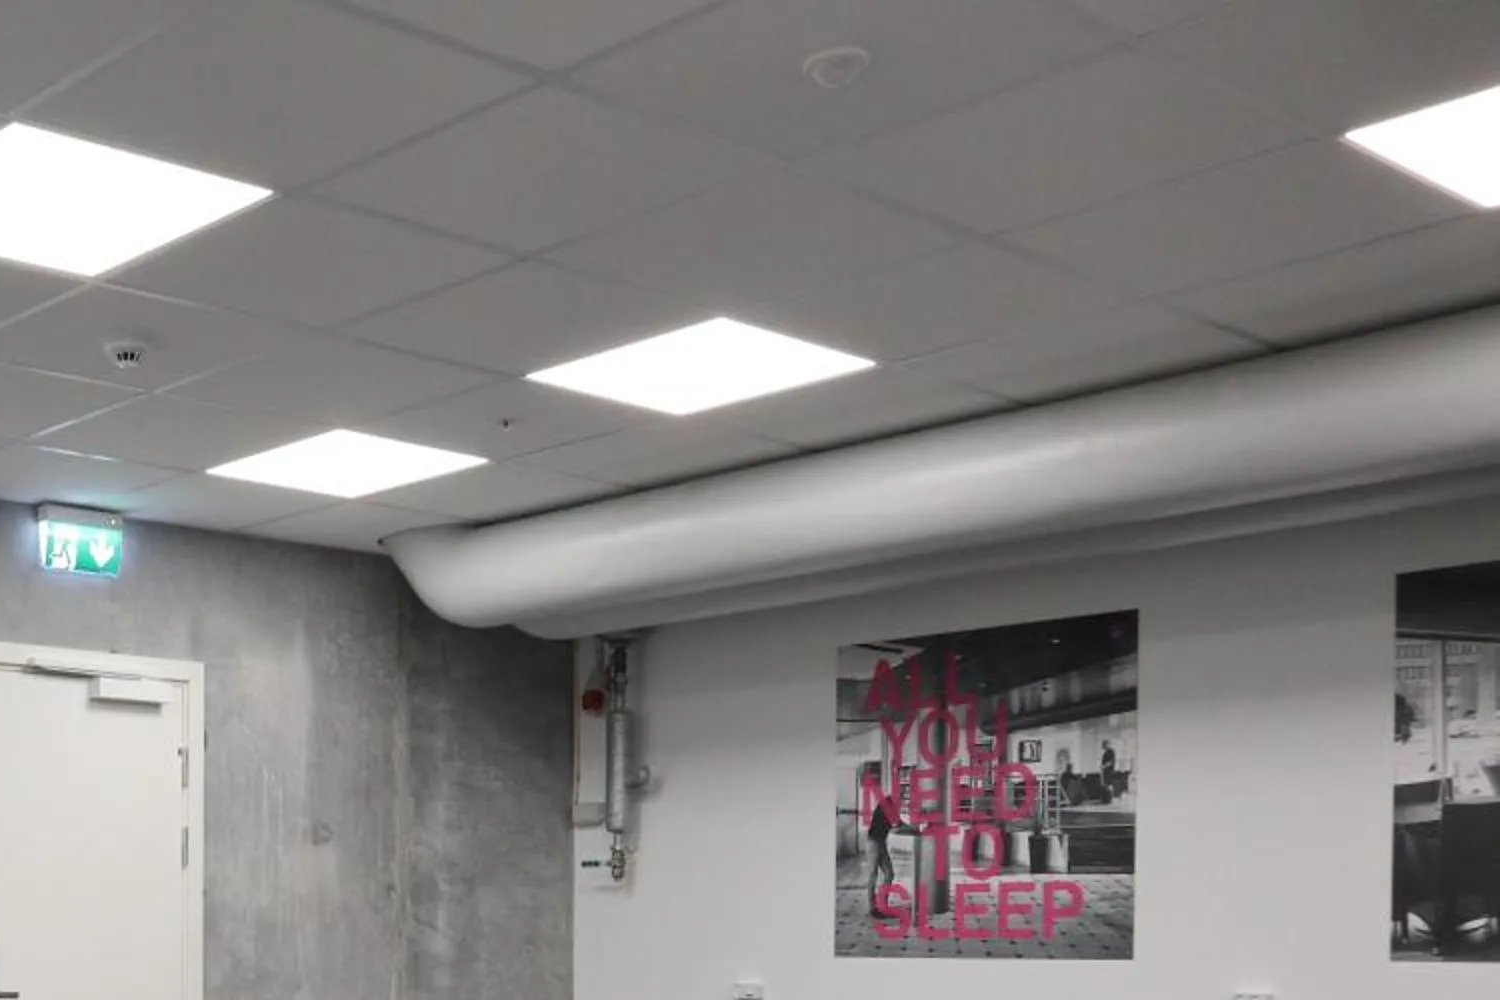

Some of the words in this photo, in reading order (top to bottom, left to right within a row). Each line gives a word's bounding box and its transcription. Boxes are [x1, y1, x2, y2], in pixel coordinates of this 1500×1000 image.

[860, 648, 977, 713] ALL
[879, 700, 1009, 768] YOU
[861, 761, 1037, 827] NEED
[924, 824, 1005, 881] TO
[872, 880, 1086, 940] SLEEP
